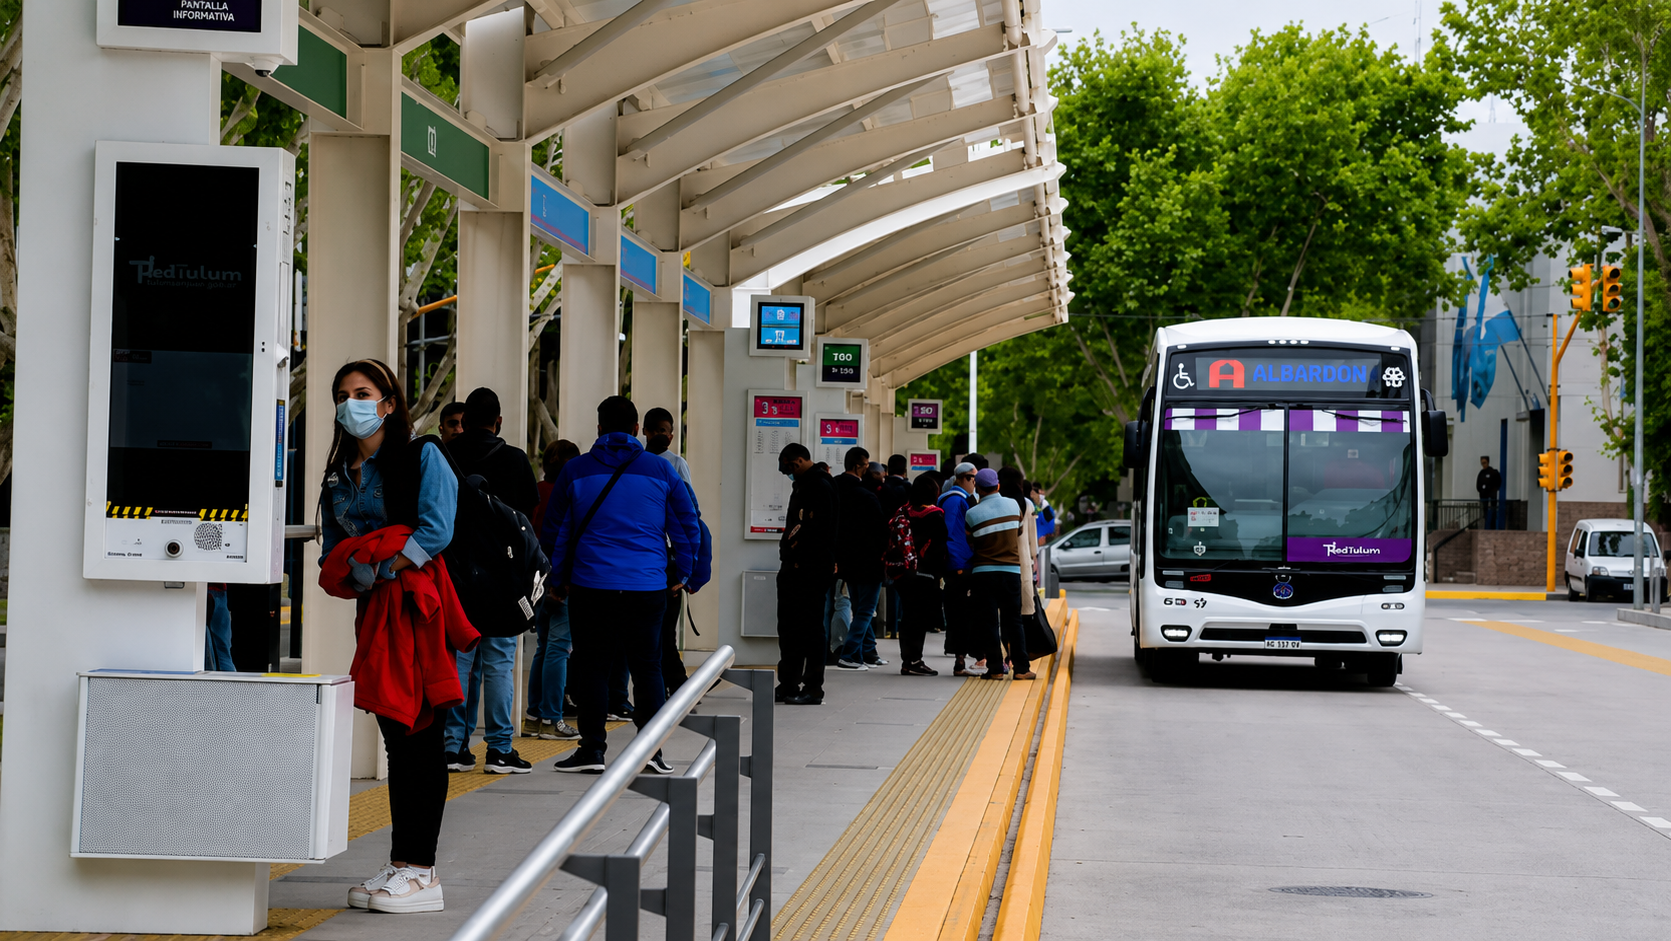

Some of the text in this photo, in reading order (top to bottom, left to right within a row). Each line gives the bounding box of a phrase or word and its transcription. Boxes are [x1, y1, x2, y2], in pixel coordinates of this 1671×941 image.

[180, 0, 229, 11] PANTALLA
[173, 10, 235, 22] INFORMATIVA
[1208, 359, 1367, 389] A ALBARDON
